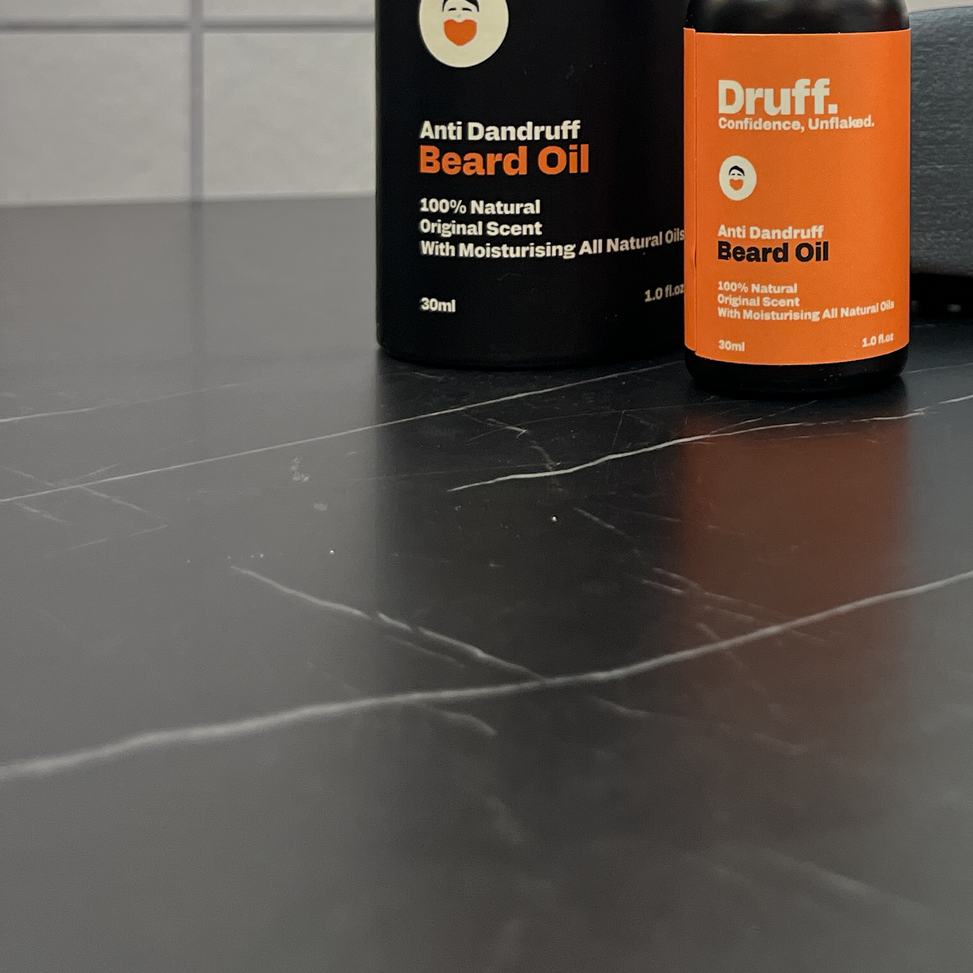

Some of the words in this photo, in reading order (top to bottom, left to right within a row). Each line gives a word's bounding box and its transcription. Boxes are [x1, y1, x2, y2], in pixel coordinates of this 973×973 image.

[718, 78, 838, 116] Druff.
[419, 120, 462, 140] Anti
[468, 119, 581, 141] Dandruff
[718, 116, 805, 133] Confidence,
[808, 115, 875, 130] Unflaked.
[419, 145, 528, 175] Beard
[538, 143, 589, 175] Oil
[419, 198, 466, 214] 100%
[470, 199, 540, 215] Natural
[419, 219, 482, 237] Original
[486, 221, 542, 235] Scent
[718, 224, 746, 238] Anti
[750, 225, 824, 240] Dandruff
[420, 240, 455, 257] With
[458, 241, 576, 259] Moisturising
[578, 239, 602, 255] All
[606, 231, 662, 253] Natural
[665, 228, 684, 243] Oils
[718, 241, 789, 262] Beard
[795, 241, 829, 262] Oil
[644, 287, 663, 302] 1.0
[718, 281, 748, 292] 100%
[751, 283, 797, 294] Natural
[420, 297, 456, 313] 30ml
[718, 294, 760, 307] Original
[762, 297, 800, 307] Scent
[718, 307, 741, 319] With
[743, 309, 820, 322] Moisturising
[822, 308, 838, 319] All
[841, 302, 878, 317] Natural
[880, 299, 894, 312] Oils
[718, 340, 745, 352] 30ml
[862, 337, 877, 348] 1.0
